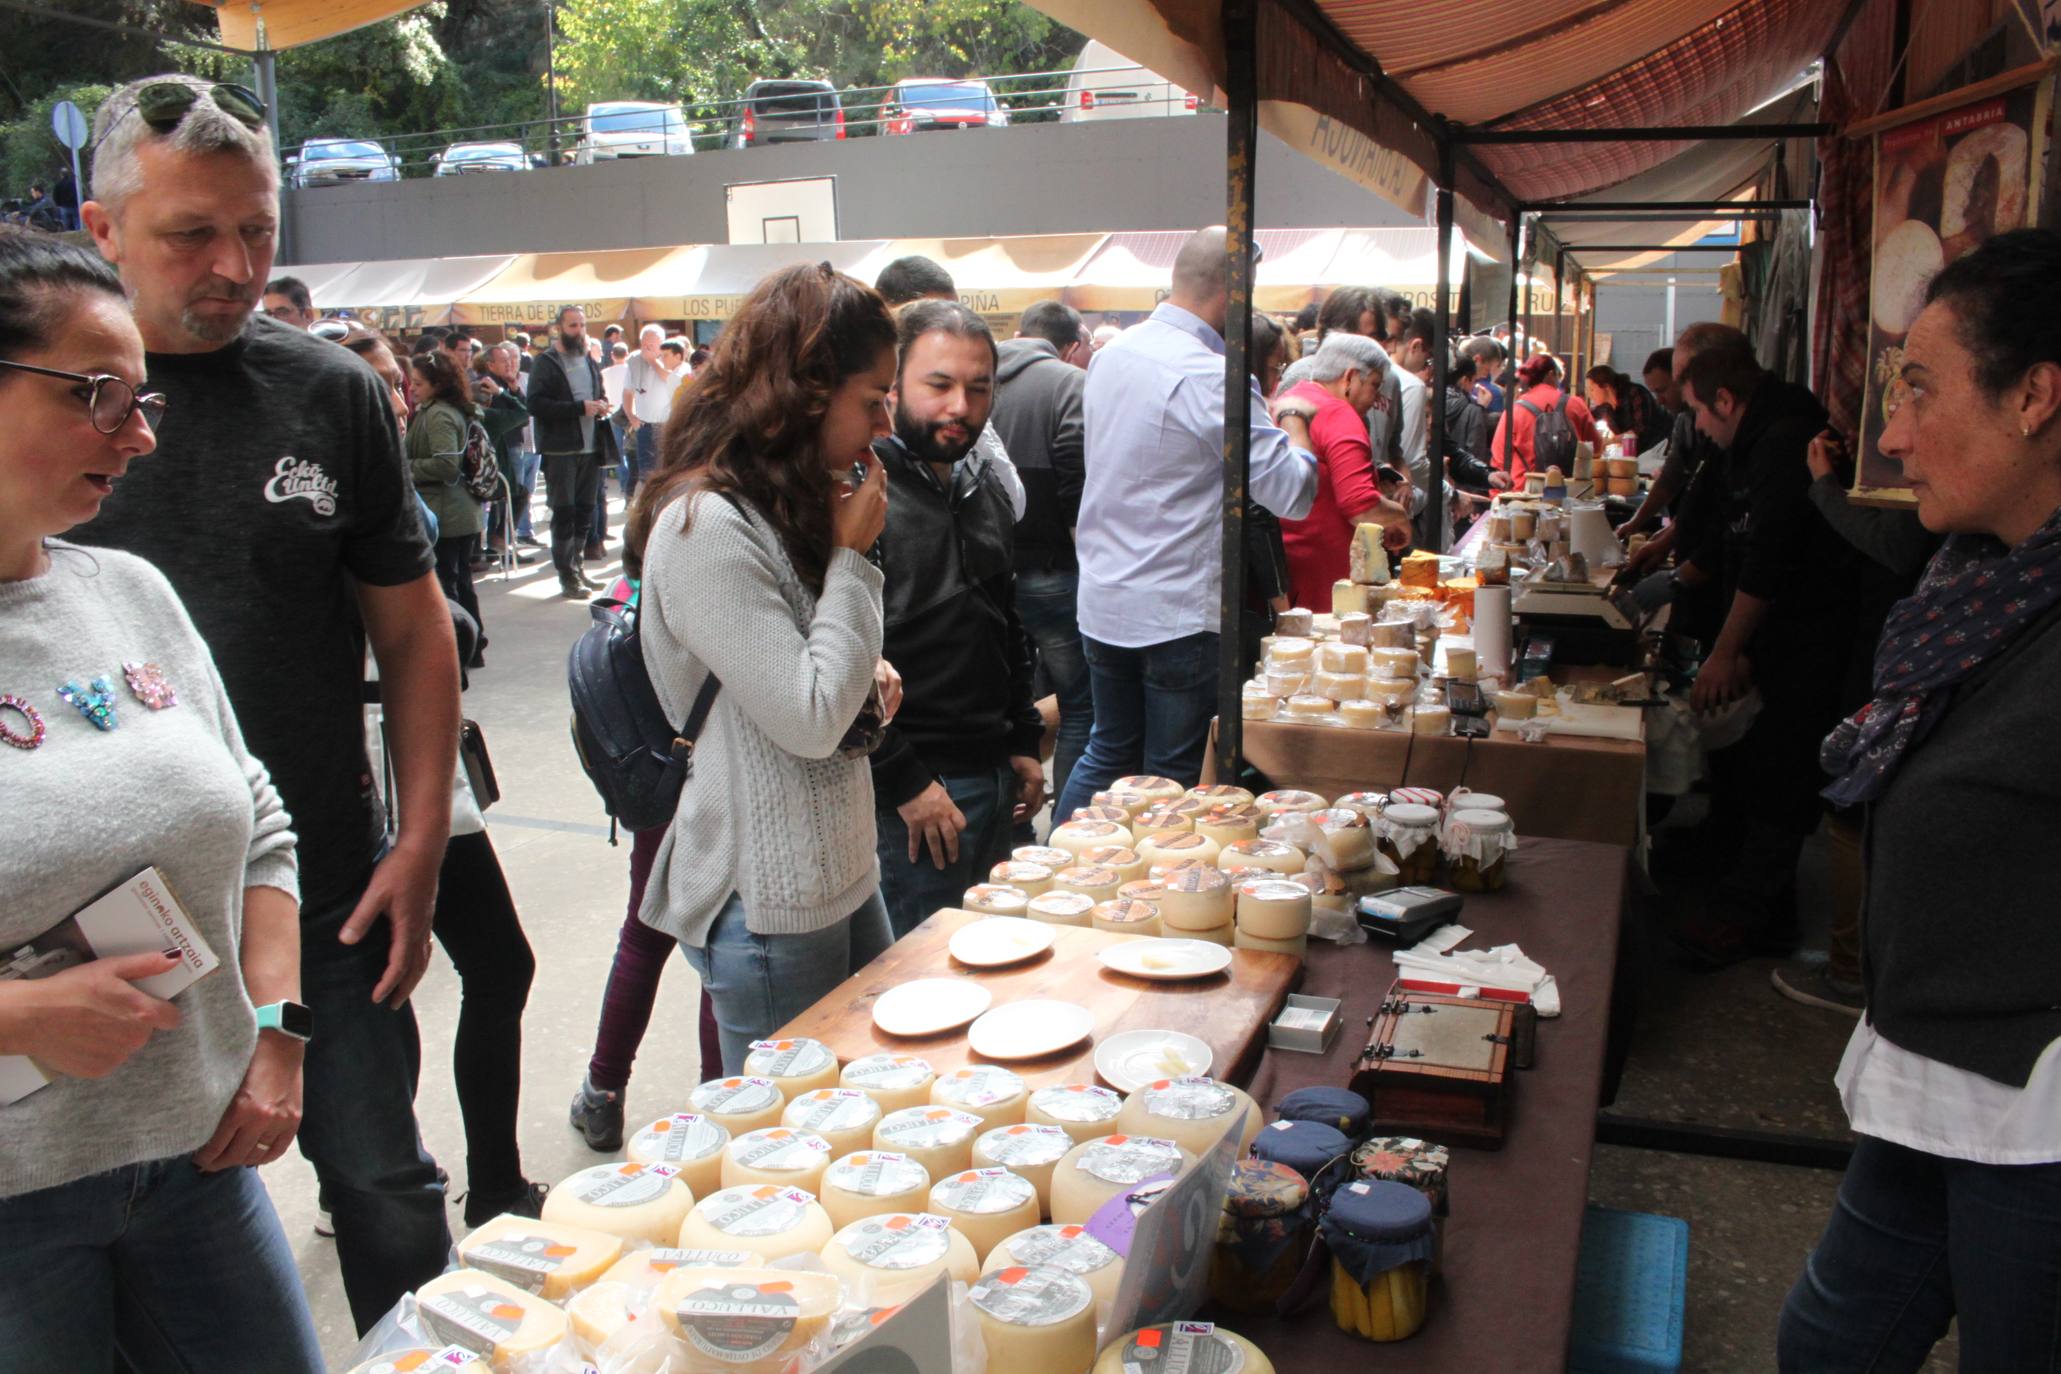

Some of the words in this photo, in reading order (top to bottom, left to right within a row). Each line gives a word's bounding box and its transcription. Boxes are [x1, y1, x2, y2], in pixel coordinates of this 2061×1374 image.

[479, 303, 525, 322] TIERRA
[527, 304, 544, 321] DE
[682, 298, 710, 316] LOS
[169, 925, 205, 970] artzaia
[662, 1249, 742, 1261] VALLUCO
[690, 1301, 789, 1316] VALLUCO
